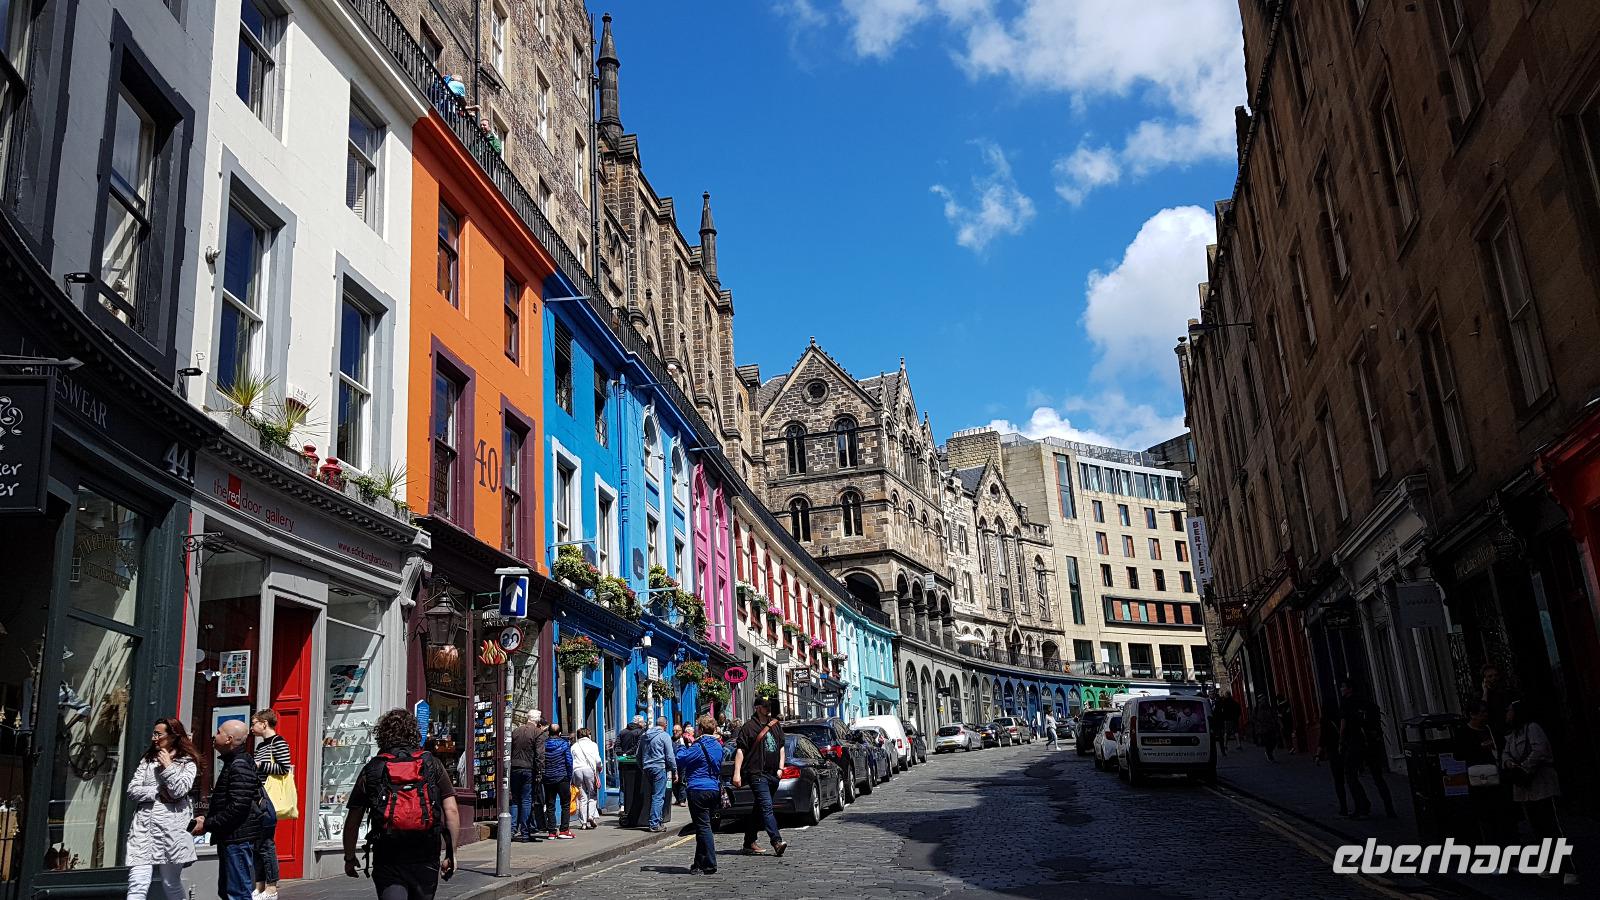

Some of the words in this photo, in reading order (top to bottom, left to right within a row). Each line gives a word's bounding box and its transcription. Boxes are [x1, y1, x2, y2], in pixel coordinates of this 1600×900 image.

[0, 461, 23, 477] er
[474, 438, 499, 493] 40
[213, 478, 228, 500] the
[228, 488, 241, 506] red
[242, 495, 263, 516] door
[265, 507, 295, 533] gallery
[502, 633, 520, 648] 20
